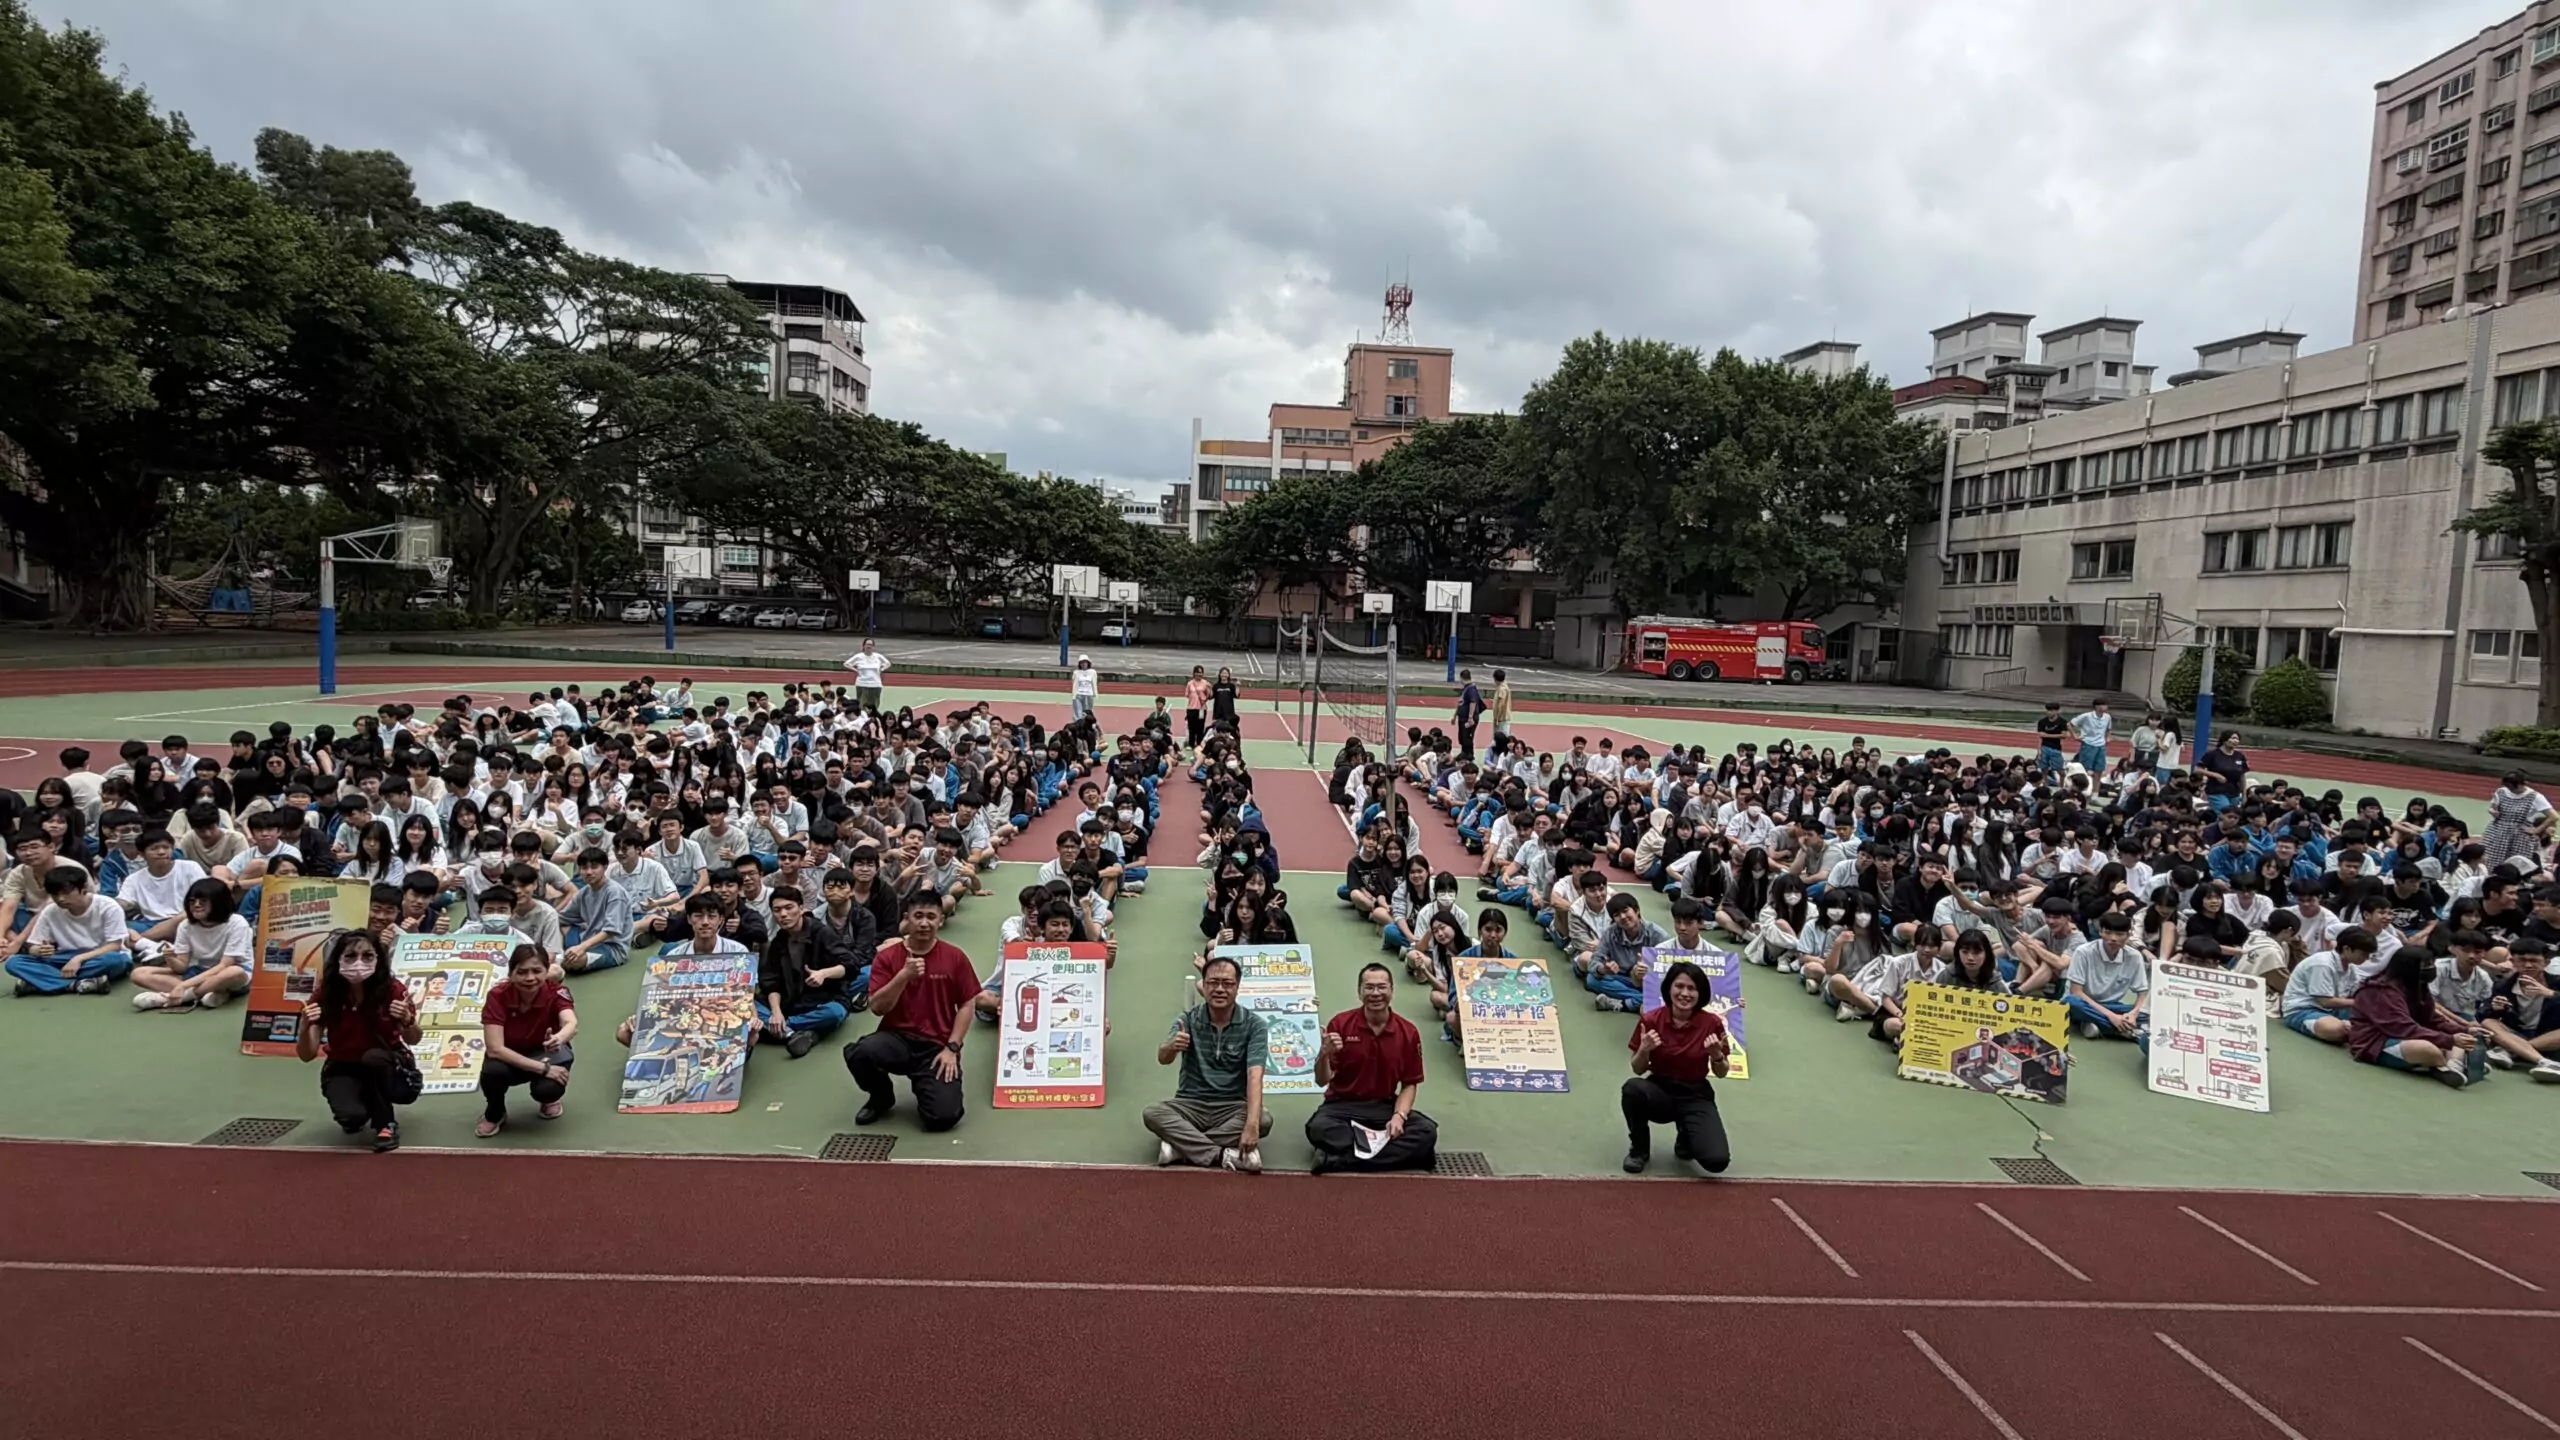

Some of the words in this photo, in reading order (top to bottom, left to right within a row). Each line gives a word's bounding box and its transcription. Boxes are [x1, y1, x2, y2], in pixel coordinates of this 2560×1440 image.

[1052, 962, 1098, 975] 使用口訣
[1472, 1003, 1546, 1020] 防溺十招
